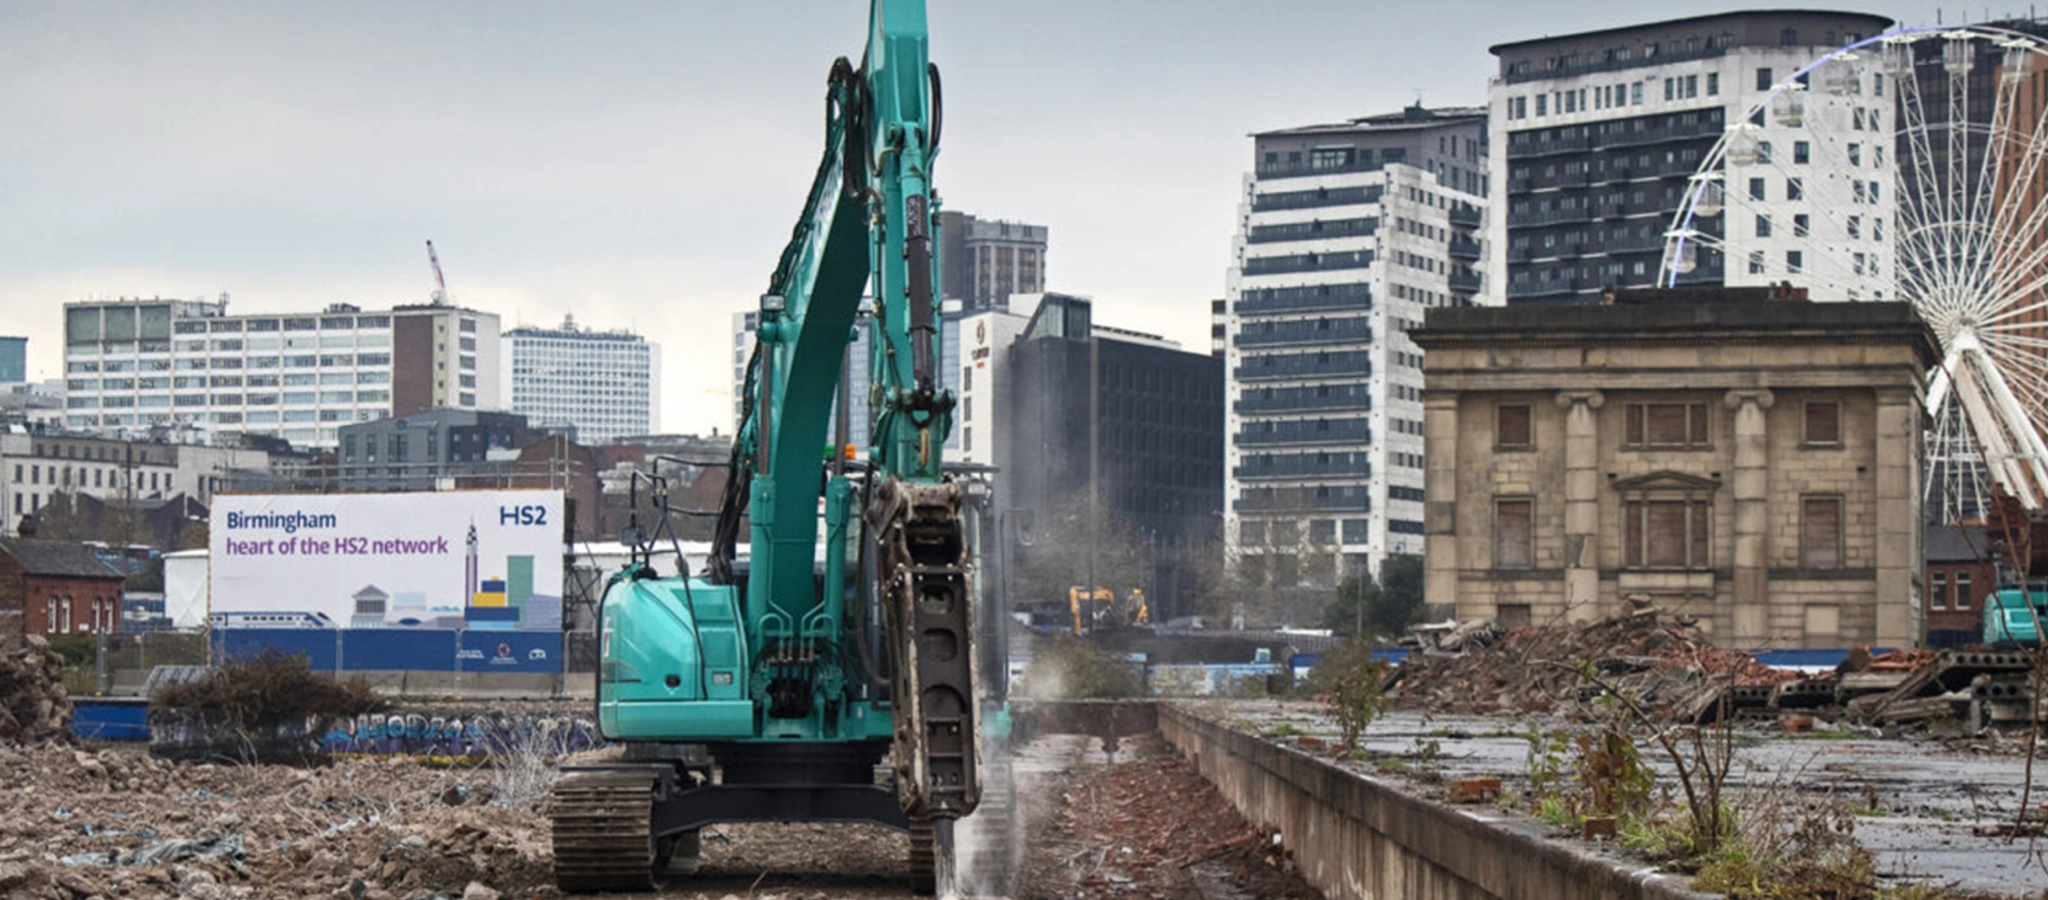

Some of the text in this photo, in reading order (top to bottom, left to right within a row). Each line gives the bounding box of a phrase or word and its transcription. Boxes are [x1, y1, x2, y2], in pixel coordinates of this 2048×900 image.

[227, 510, 336, 533] Birmingham
[500, 505, 547, 525] HS2
[226, 535, 448, 555] heart of the HS2 network
